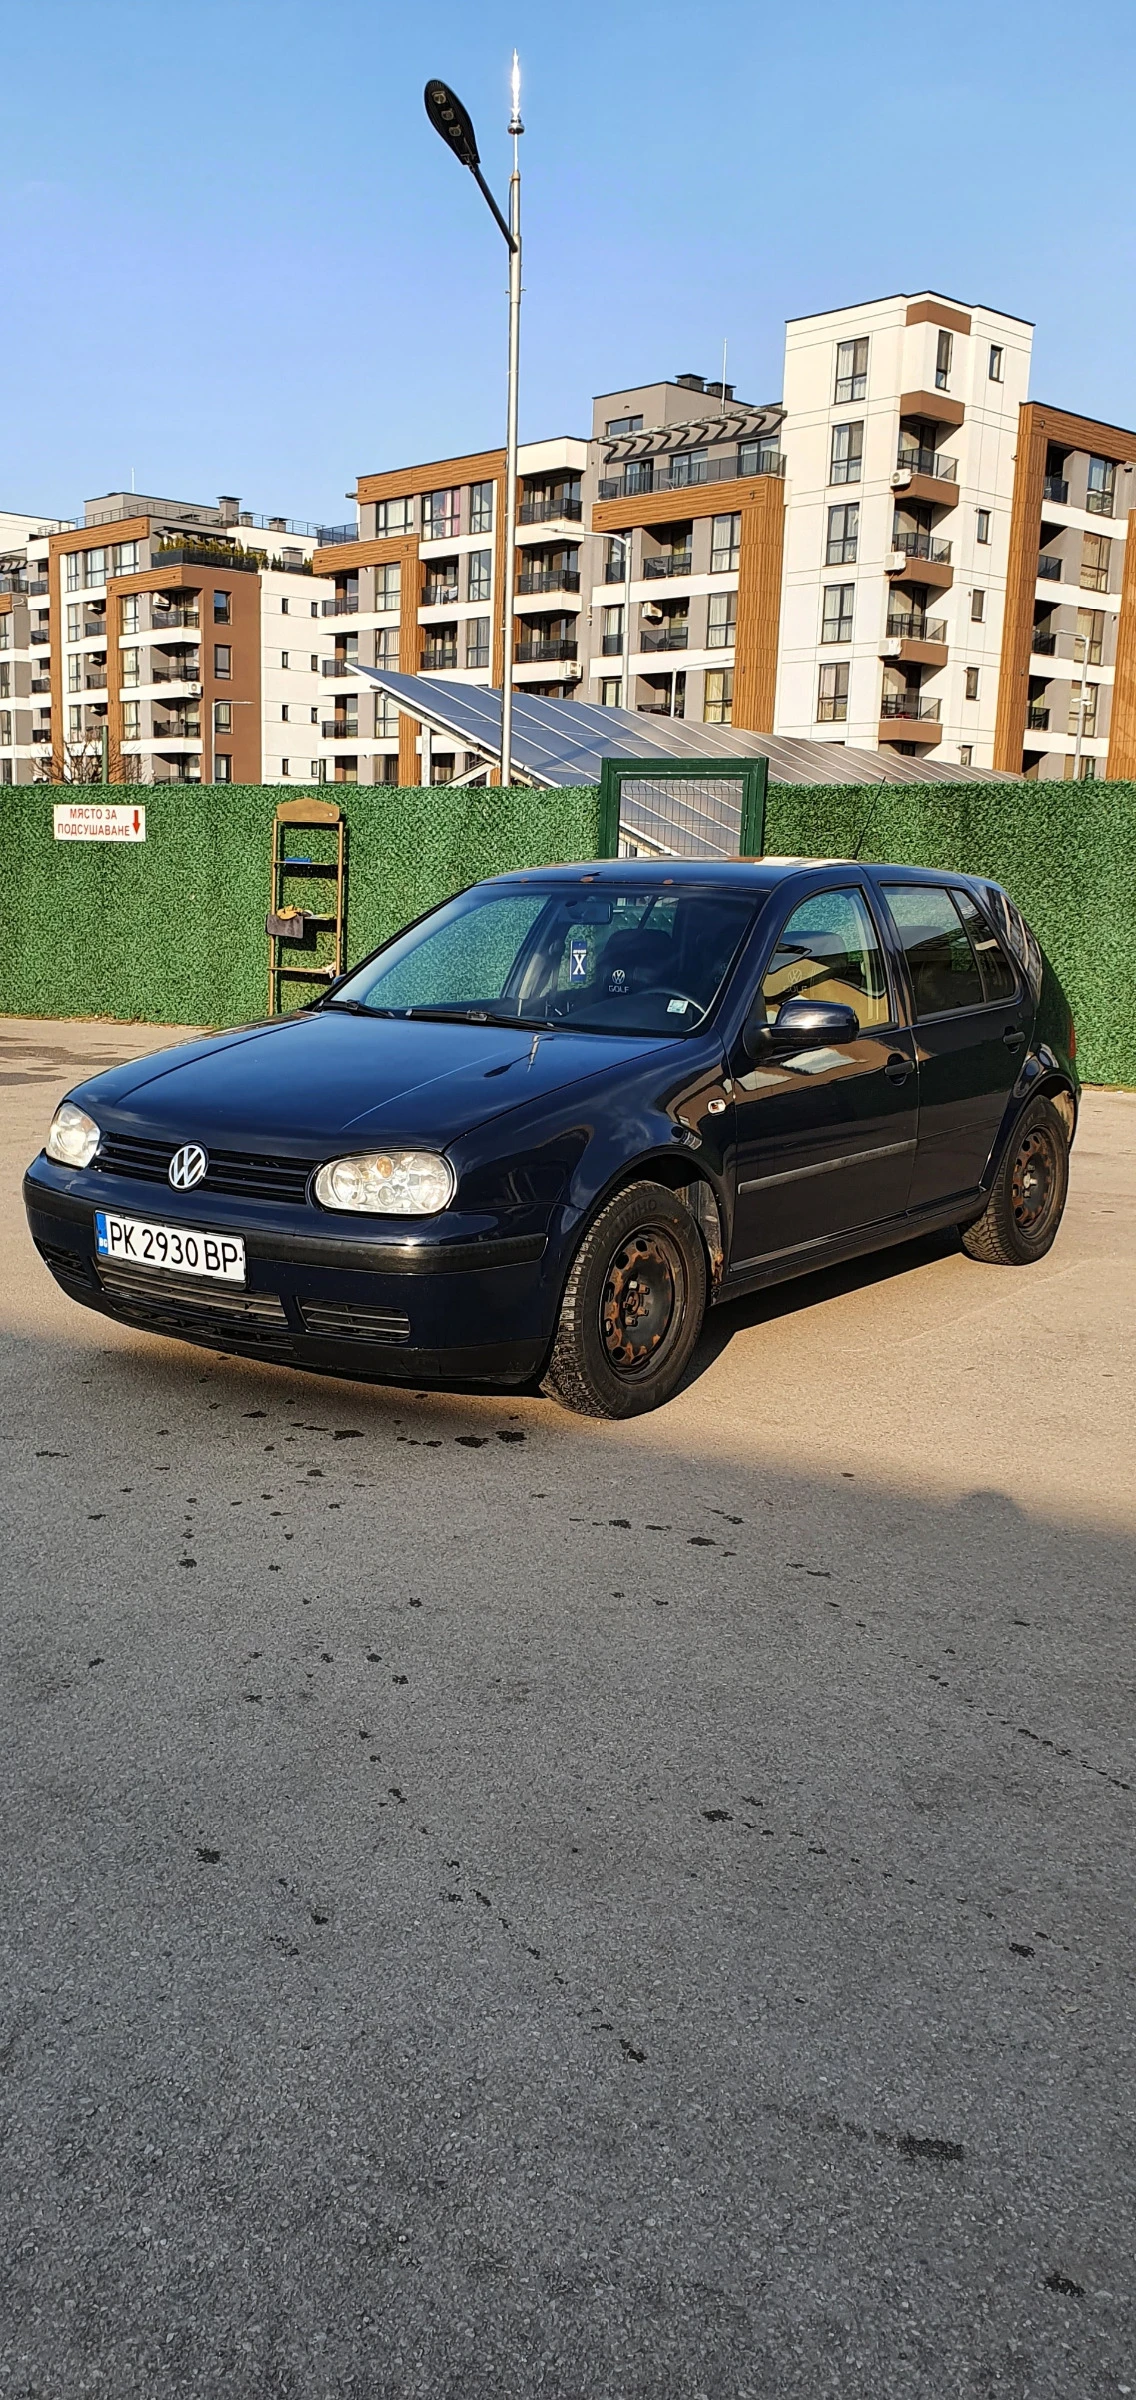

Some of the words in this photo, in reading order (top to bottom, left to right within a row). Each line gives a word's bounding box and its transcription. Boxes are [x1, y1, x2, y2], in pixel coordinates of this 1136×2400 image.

[70, 808, 103, 819] МЯСТО
[105, 809, 117, 820] ЗА
[57, 823, 130, 836] ПОДСУШАВАНЕ
[608, 985, 629, 993] GOLF
[98, 1236, 108, 1248] BG
[109, 1221, 137, 1256] PK
[141, 1228, 199, 1268] 2930
[203, 1239, 238, 1273] BP
